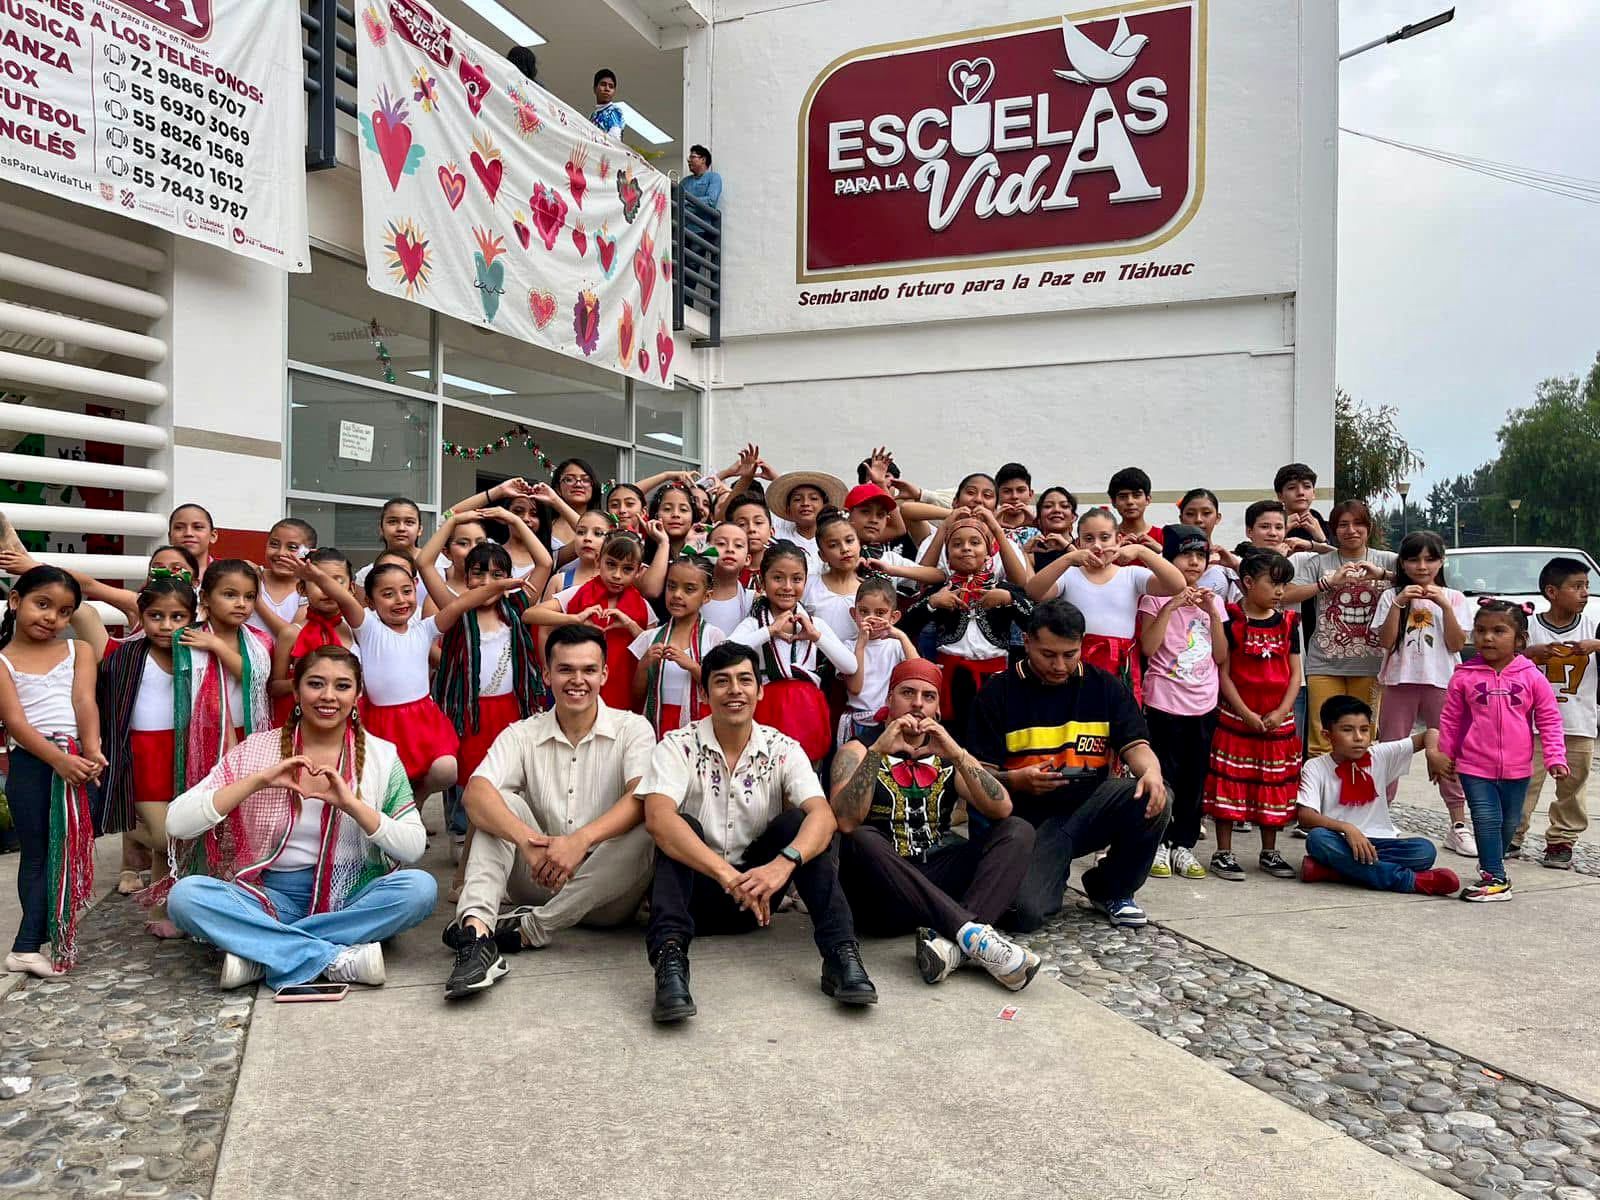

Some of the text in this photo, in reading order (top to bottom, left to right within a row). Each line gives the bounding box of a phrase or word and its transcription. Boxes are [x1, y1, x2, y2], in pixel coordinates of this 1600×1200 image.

[0, 27, 73, 74] ANZA
[120, 11, 140, 26] para
[142, 20, 150, 30] la
[151, 25, 168, 38] Paz
[0, 57, 39, 89] OX
[89, 11, 107, 33] A
[111, 20, 151, 52] LOS
[155, 40, 264, 105] TELÉFONOS:
[128, 54, 247, 118] 72 9886 6707
[131, 83, 250, 146] 55 6930 3069
[133, 109, 244, 168] 55 8826 1568
[829, 77, 1169, 190] ESCUELAS
[132, 137, 243, 194] 55 3420 1612
[835, 176, 883, 196] PARA
[884, 172, 910, 190] LA
[132, 166, 248, 220] 55 7843 9787
[798, 261, 1196, 306] Sembrando futuro para la Paz en Tláhuac
[1077, 736, 1106, 752] BOSS
